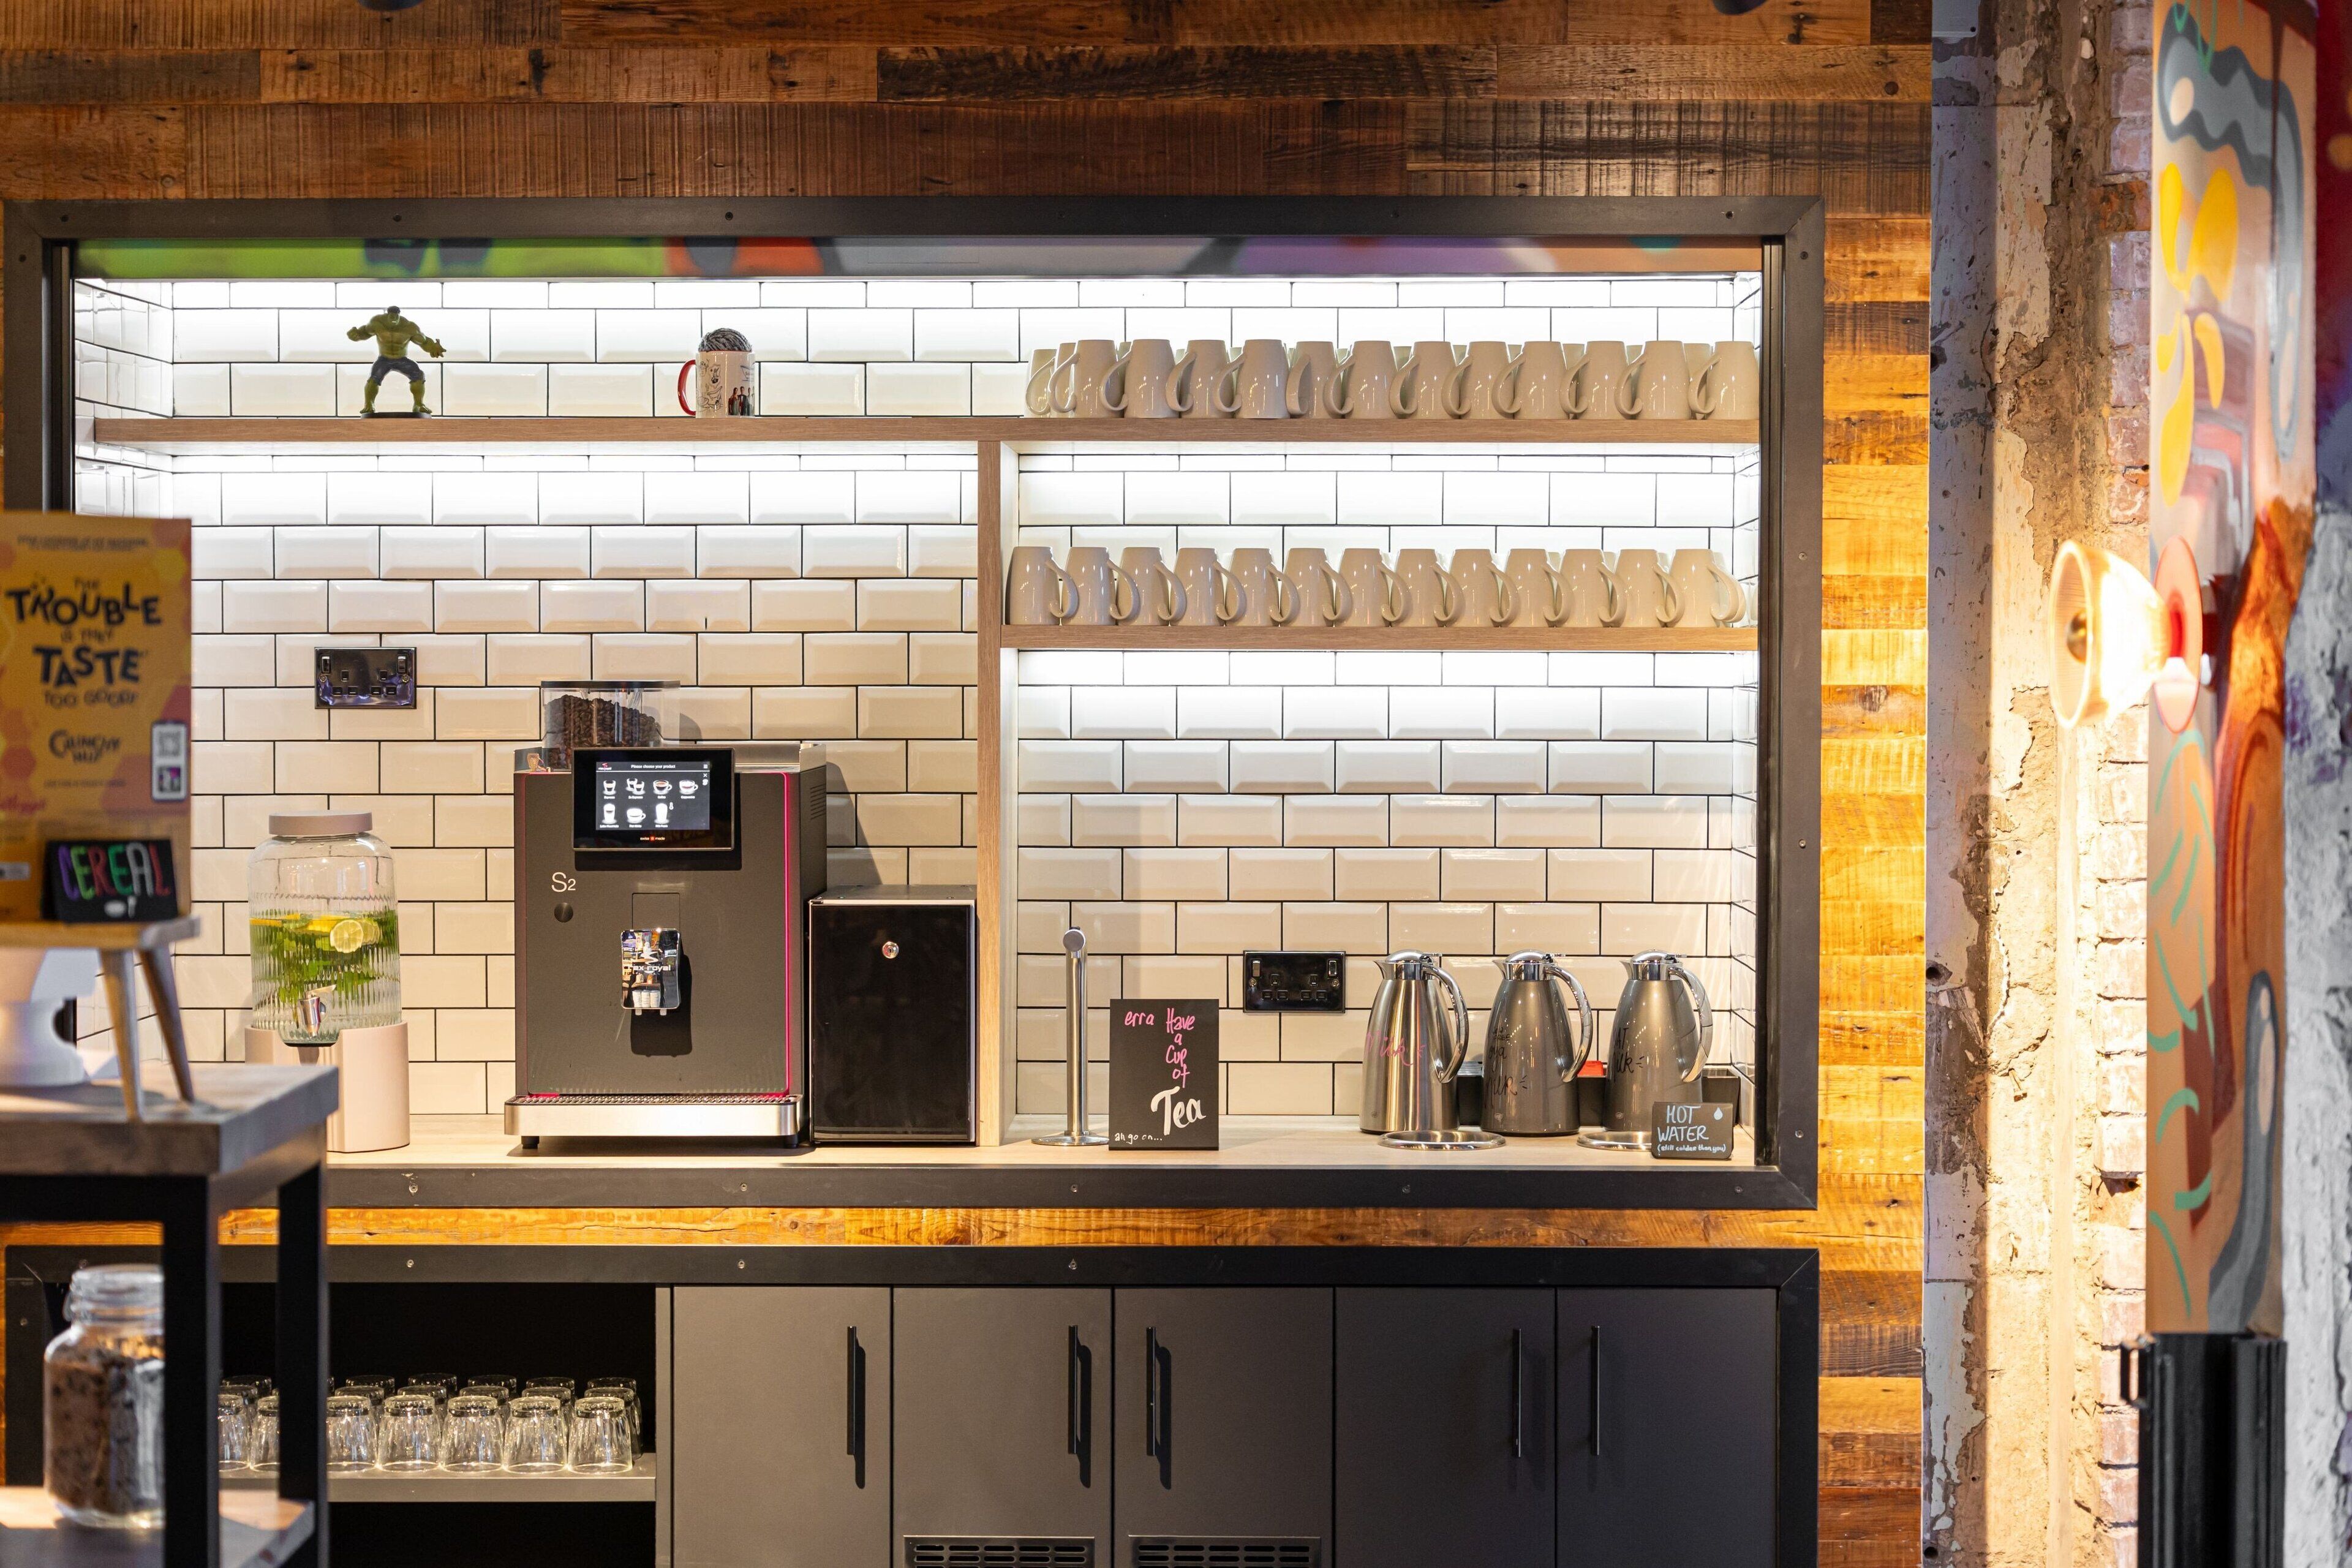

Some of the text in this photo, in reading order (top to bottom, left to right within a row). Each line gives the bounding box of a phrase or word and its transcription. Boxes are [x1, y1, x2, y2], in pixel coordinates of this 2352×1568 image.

[5, 582, 162, 625] TROUBLE
[33, 646, 140, 687] TASTE
[58, 842, 170, 900] CEREAL
[1166, 1008, 1195, 1034] Have
[1174, 1033, 1182, 1046] a
[1166, 1045, 1187, 1067] Cup
[1172, 1063, 1190, 1088] of
[1150, 1086, 1207, 1136] Tea
[1666, 1105, 1701, 1124] HOT
[1126, 1134, 1139, 1145] go
[1657, 1125, 1709, 1142] WATER
